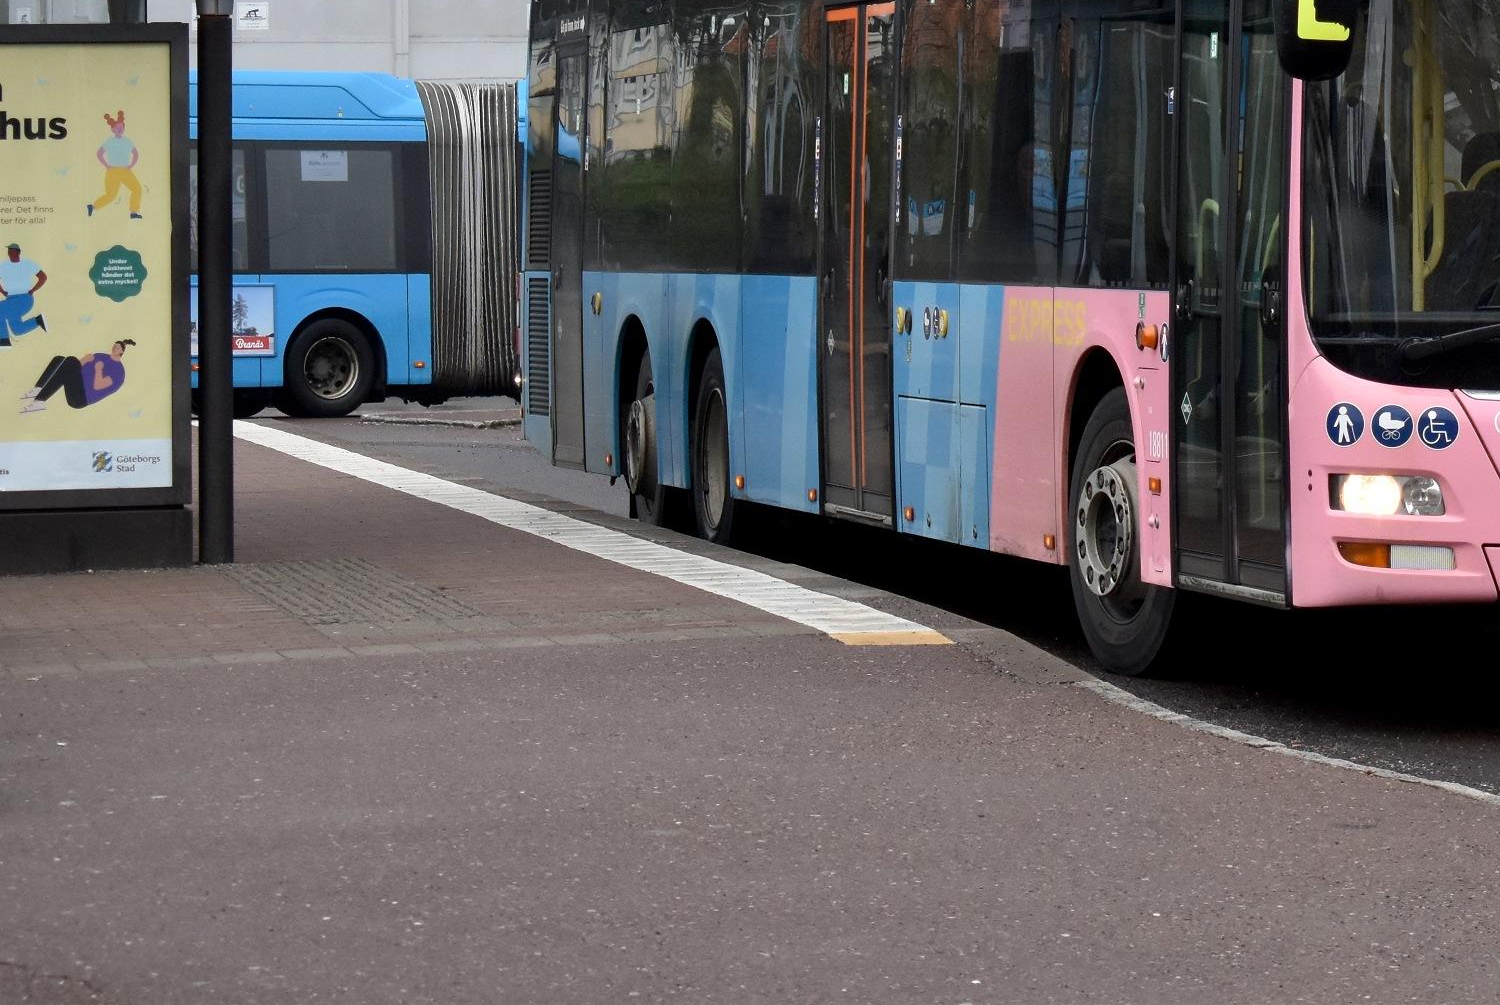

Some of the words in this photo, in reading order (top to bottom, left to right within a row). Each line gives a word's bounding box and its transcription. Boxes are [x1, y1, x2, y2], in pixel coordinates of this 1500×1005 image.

[1008, 298, 1087, 347] EXPRESS
[236, 338, 264, 349] Branäs
[1148, 429, 1168, 459] 18811
[116, 454, 161, 464] Göteborgs
[116, 464, 136, 472] Stad
